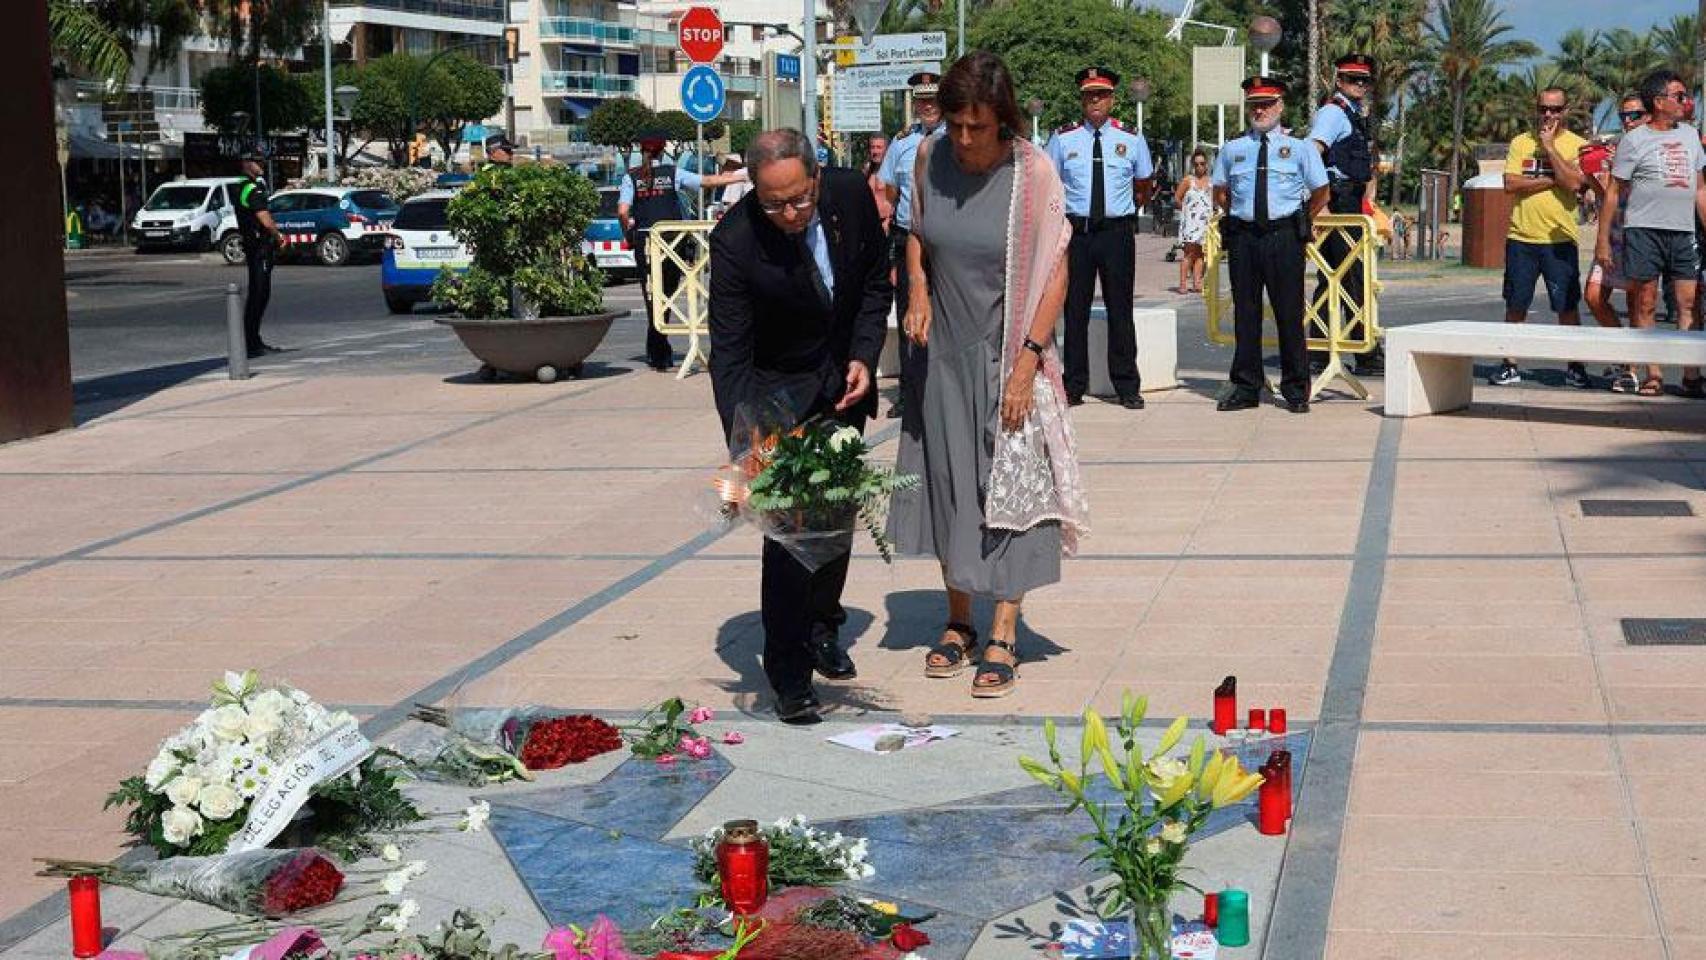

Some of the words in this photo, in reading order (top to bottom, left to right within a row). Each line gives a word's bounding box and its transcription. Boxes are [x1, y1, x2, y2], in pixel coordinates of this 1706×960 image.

[683, 28, 721, 42] STOP
[921, 34, 943, 44] Hotel
[876, 49, 888, 60] Sol
[891, 48, 908, 58] Port
[909, 47, 943, 58] Cambrils
[780, 57, 798, 74] TAXI
[242, 761, 315, 845] DELEGACIÓN
